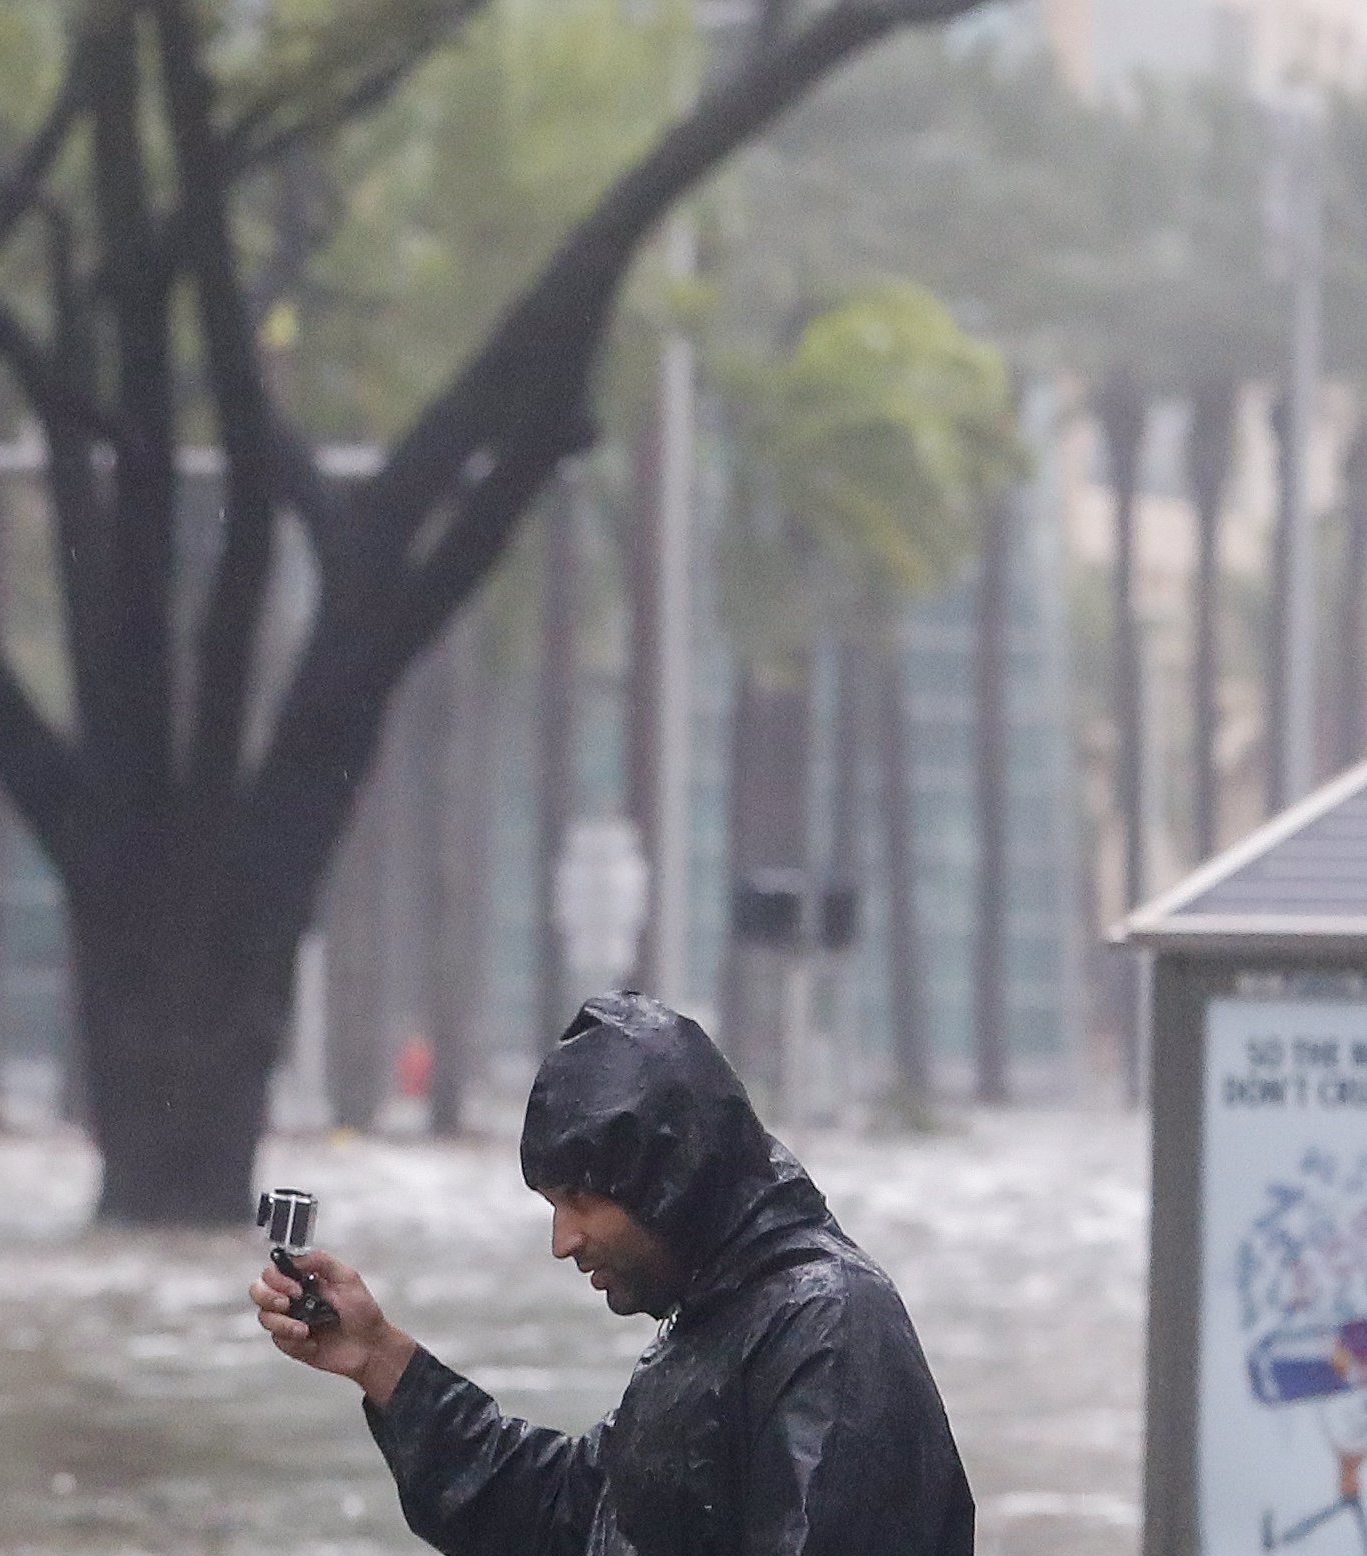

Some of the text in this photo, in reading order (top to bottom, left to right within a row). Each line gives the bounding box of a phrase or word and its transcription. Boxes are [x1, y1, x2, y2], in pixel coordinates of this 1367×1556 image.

[1248, 1036, 1283, 1067] SO
[1292, 1036, 1339, 1067] THE
[1226, 1073, 1307, 1106] DON'T
